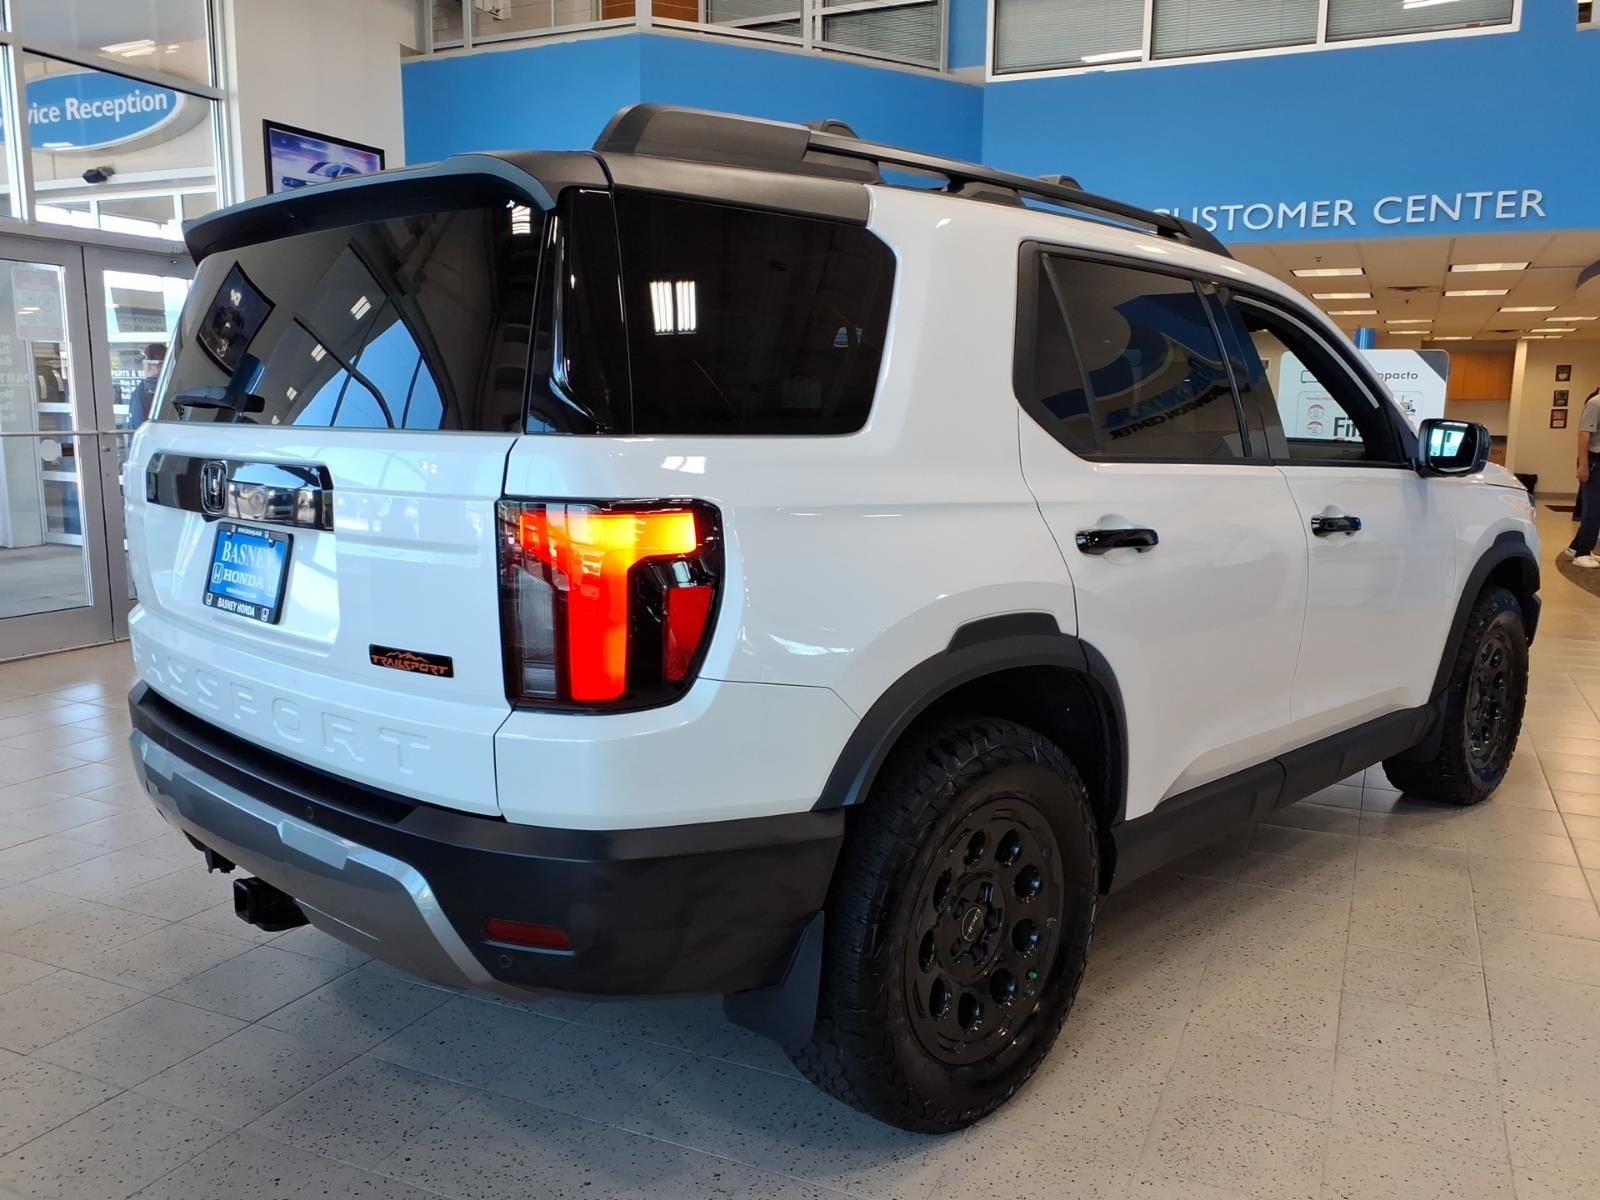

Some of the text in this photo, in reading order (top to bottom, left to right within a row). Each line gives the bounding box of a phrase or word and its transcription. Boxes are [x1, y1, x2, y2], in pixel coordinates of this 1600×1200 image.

[65, 89, 168, 122] Reception
[1372, 189, 1547, 225] CENTER
[223, 568, 264, 589] HONDA
[217, 597, 255, 616] BASNEY HONDA
[371, 654, 449, 676] TRAILSPORT
